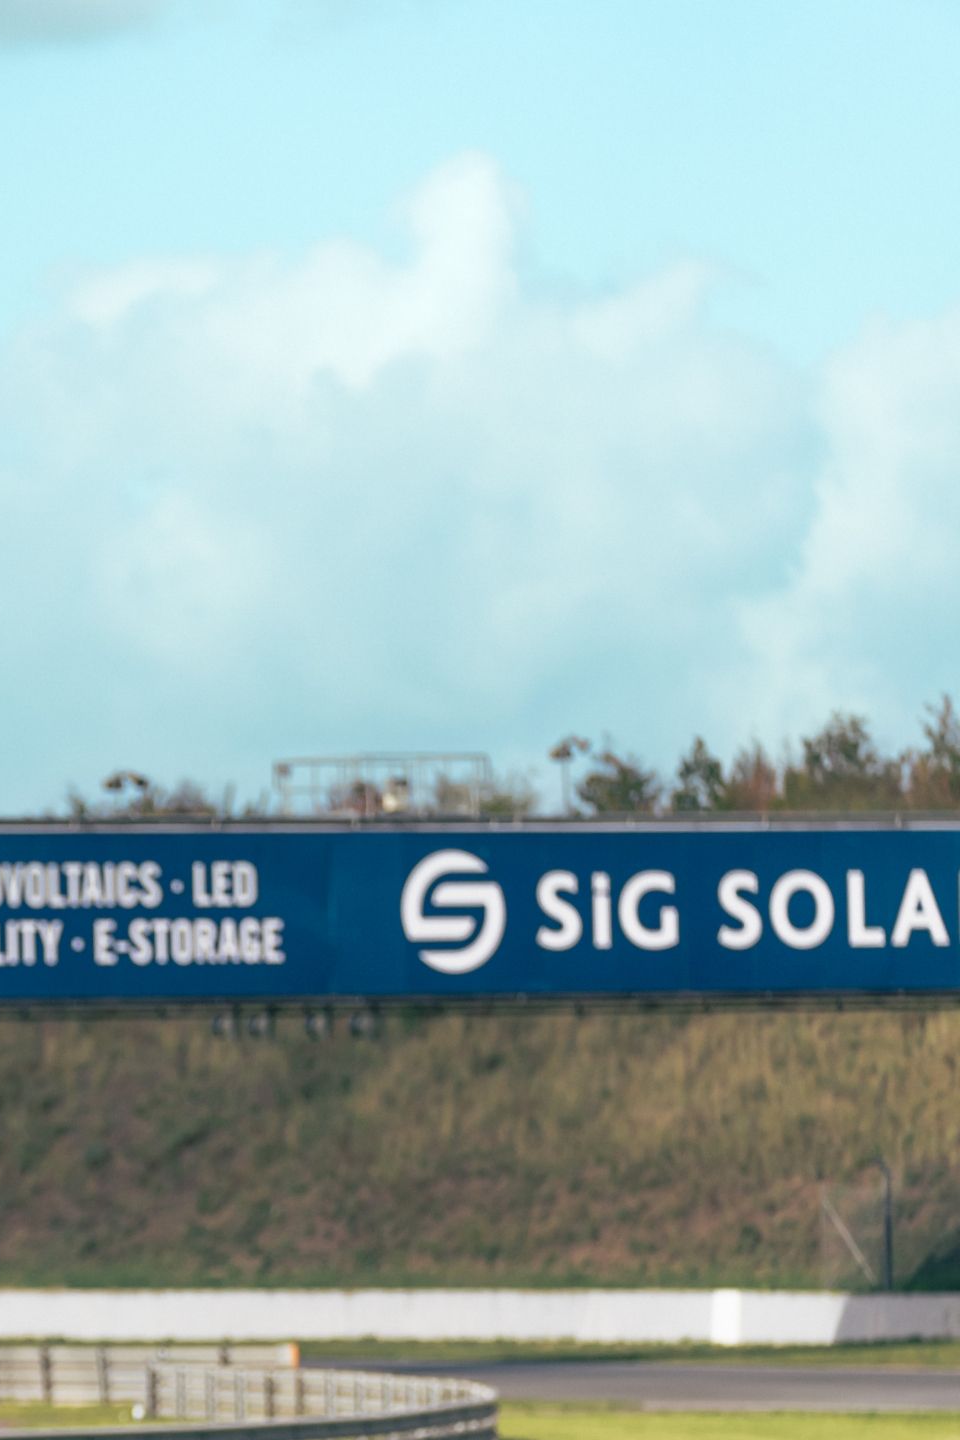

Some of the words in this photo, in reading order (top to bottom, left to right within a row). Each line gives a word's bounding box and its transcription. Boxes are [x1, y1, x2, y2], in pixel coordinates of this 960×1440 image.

[192, 861, 258, 908] LED
[717, 868, 960, 950] SOLA
[93, 917, 286, 965] E-STORAGE
